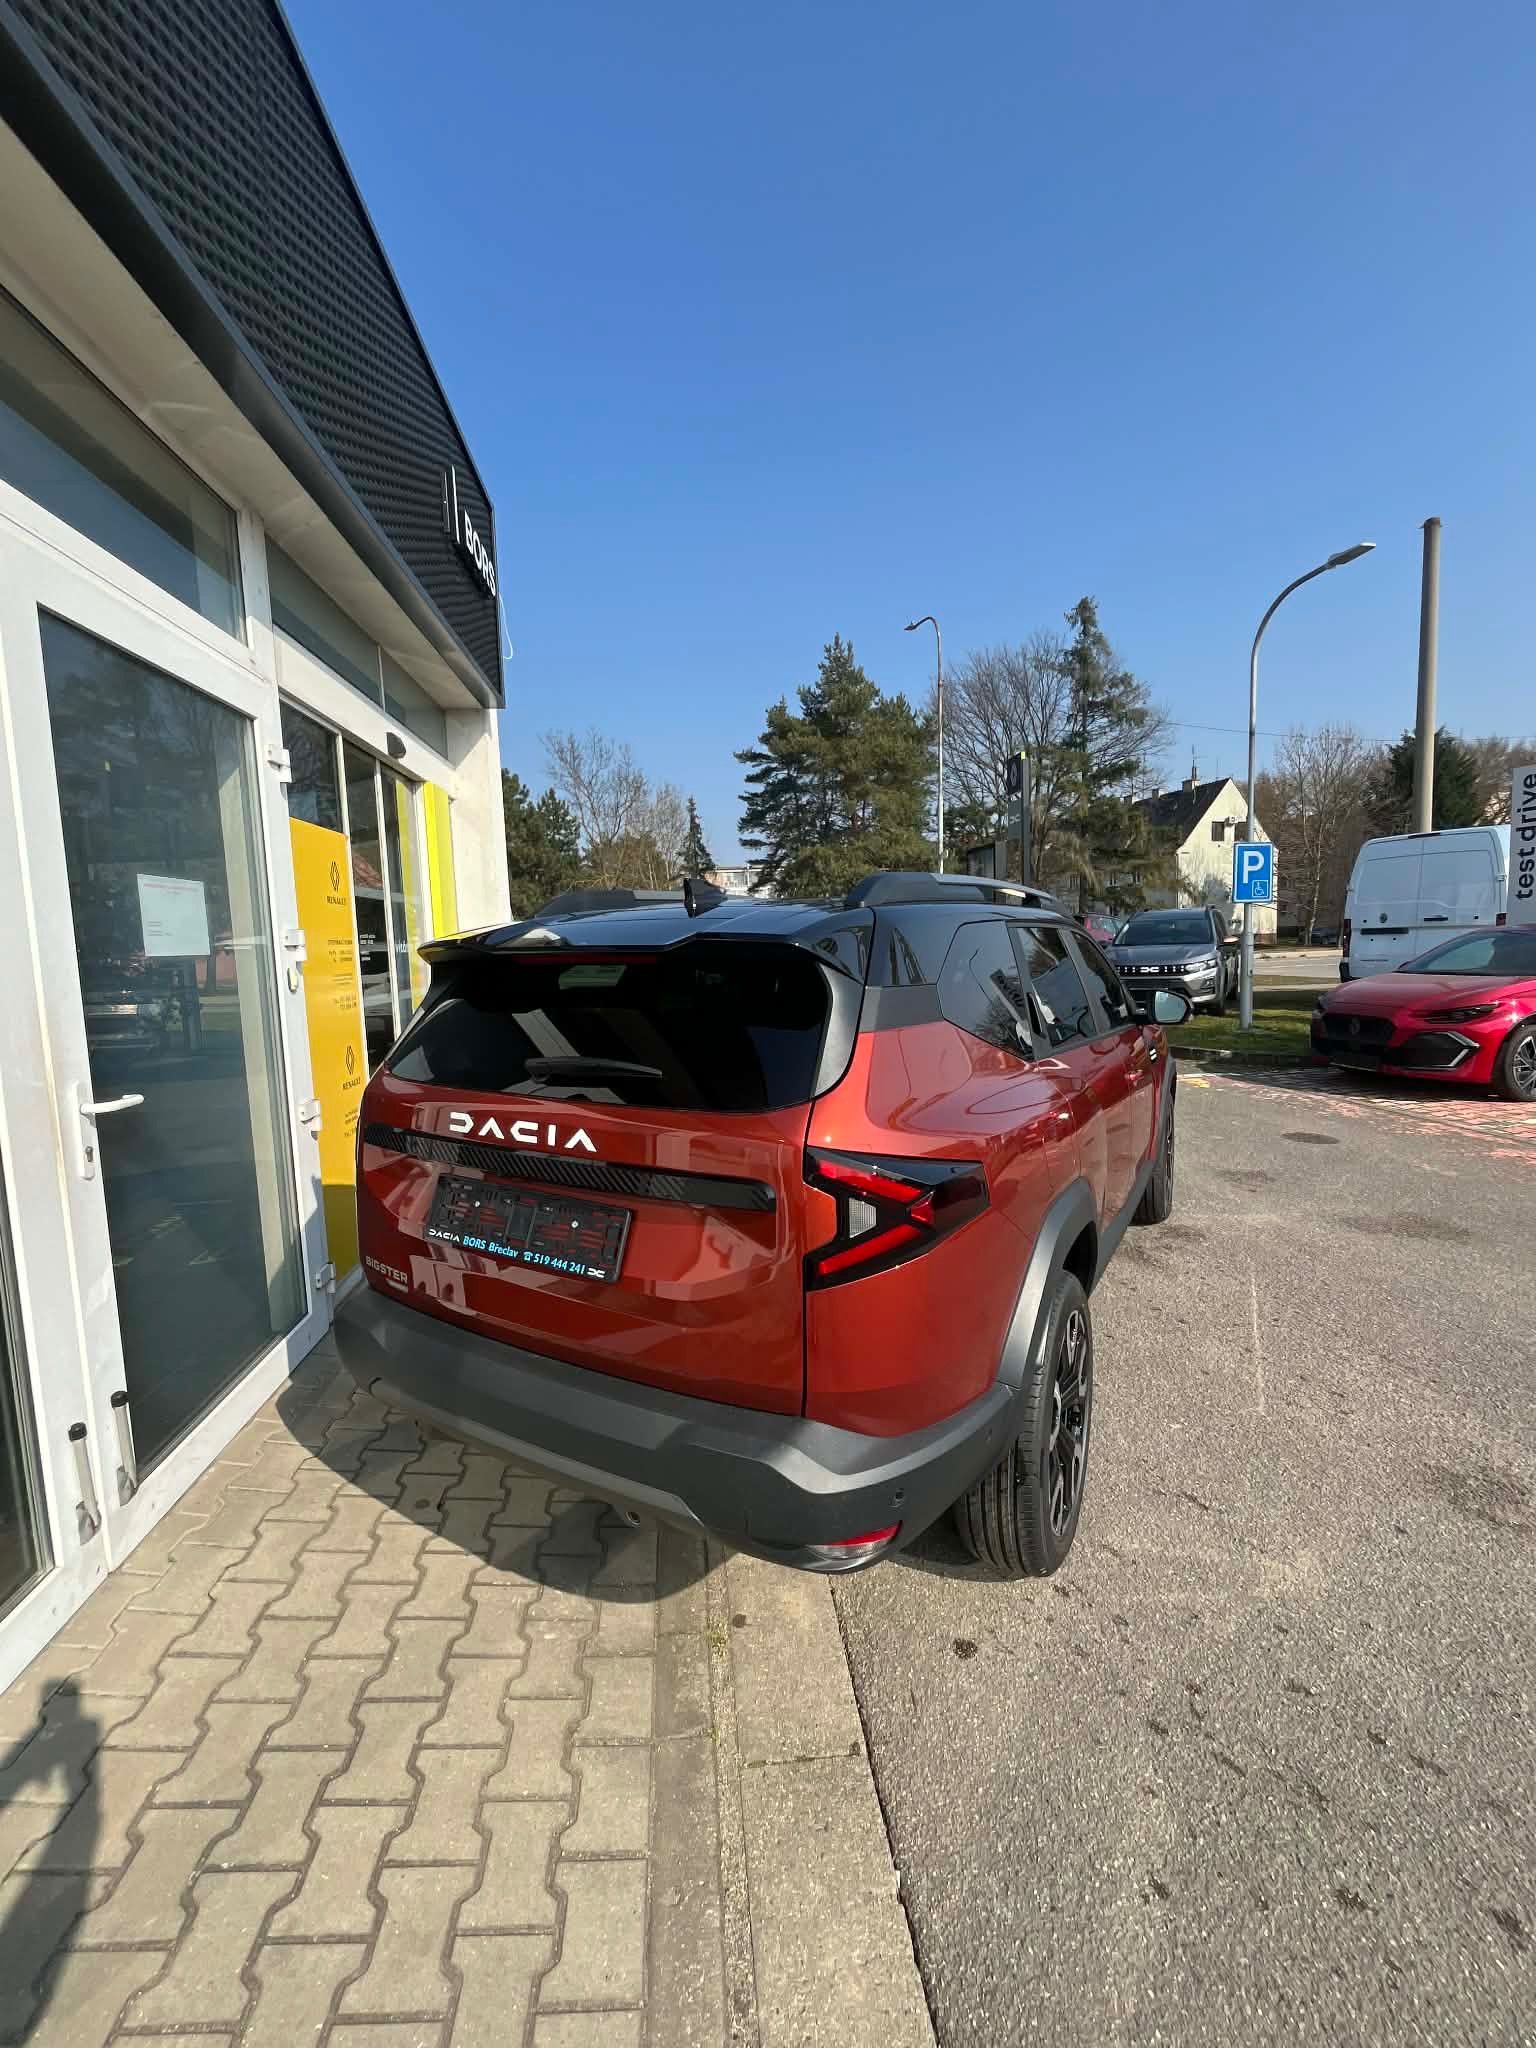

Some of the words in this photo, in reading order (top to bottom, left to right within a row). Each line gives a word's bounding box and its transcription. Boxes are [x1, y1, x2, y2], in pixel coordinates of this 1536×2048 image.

[464, 510, 496, 597] BORS
[1515, 773, 1536, 842] drive
[1243, 850, 1265, 884] P
[1515, 847, 1535, 900] test
[450, 1111, 597, 1152] DACIA
[428, 1228, 460, 1242] DACIA
[463, 1235, 486, 1250] BORS
[488, 1242, 519, 1258] Břeclav
[533, 1253, 551, 1265] 519
[550, 1257, 568, 1271] 444
[568, 1260, 585, 1275] 241
[365, 1255, 408, 1284] BIGSTER
